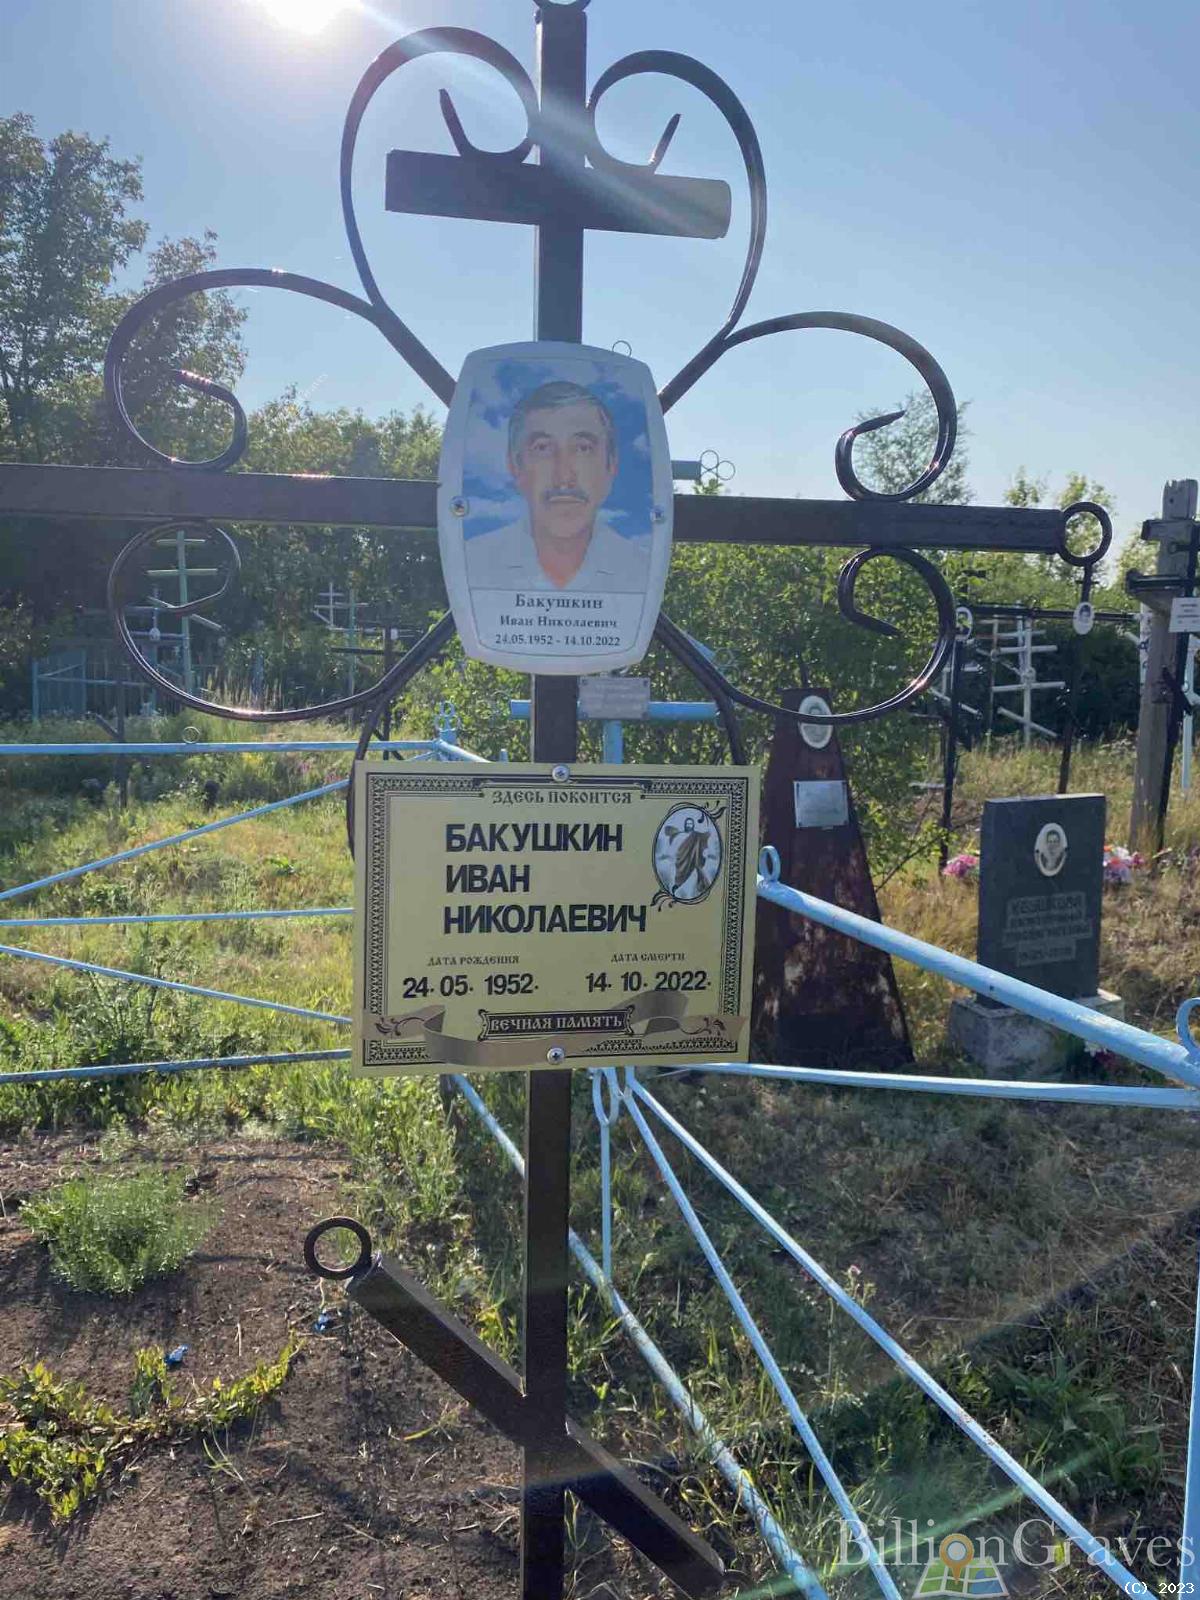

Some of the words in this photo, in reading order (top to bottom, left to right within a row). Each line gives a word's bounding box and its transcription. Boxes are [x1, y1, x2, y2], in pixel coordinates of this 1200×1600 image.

[515, 593, 604, 613] Бакушкин
[500, 615, 533, 627] Иван
[537, 616, 618, 628] Николаевич
[495, 634, 553, 646] 24.05.1952
[564, 635, 621, 647] 14.10.2022
[492, 790, 544, 805] ЗДЕСЬ
[445, 823, 623, 853] БАКУШКИН
[446, 864, 530, 894] ИВАН
[444, 904, 647, 935] НИКОЛАЕВИЧ
[427, 956, 457, 967] ДАТА
[611, 952, 638, 963] ДАТА
[484, 972, 539, 996] 1952.
[655, 970, 712, 992] 2022.
[490, 1016, 552, 1031] ВЕЧНАЯ
[556, 1015, 622, 1029] ПАМЯТЬ
